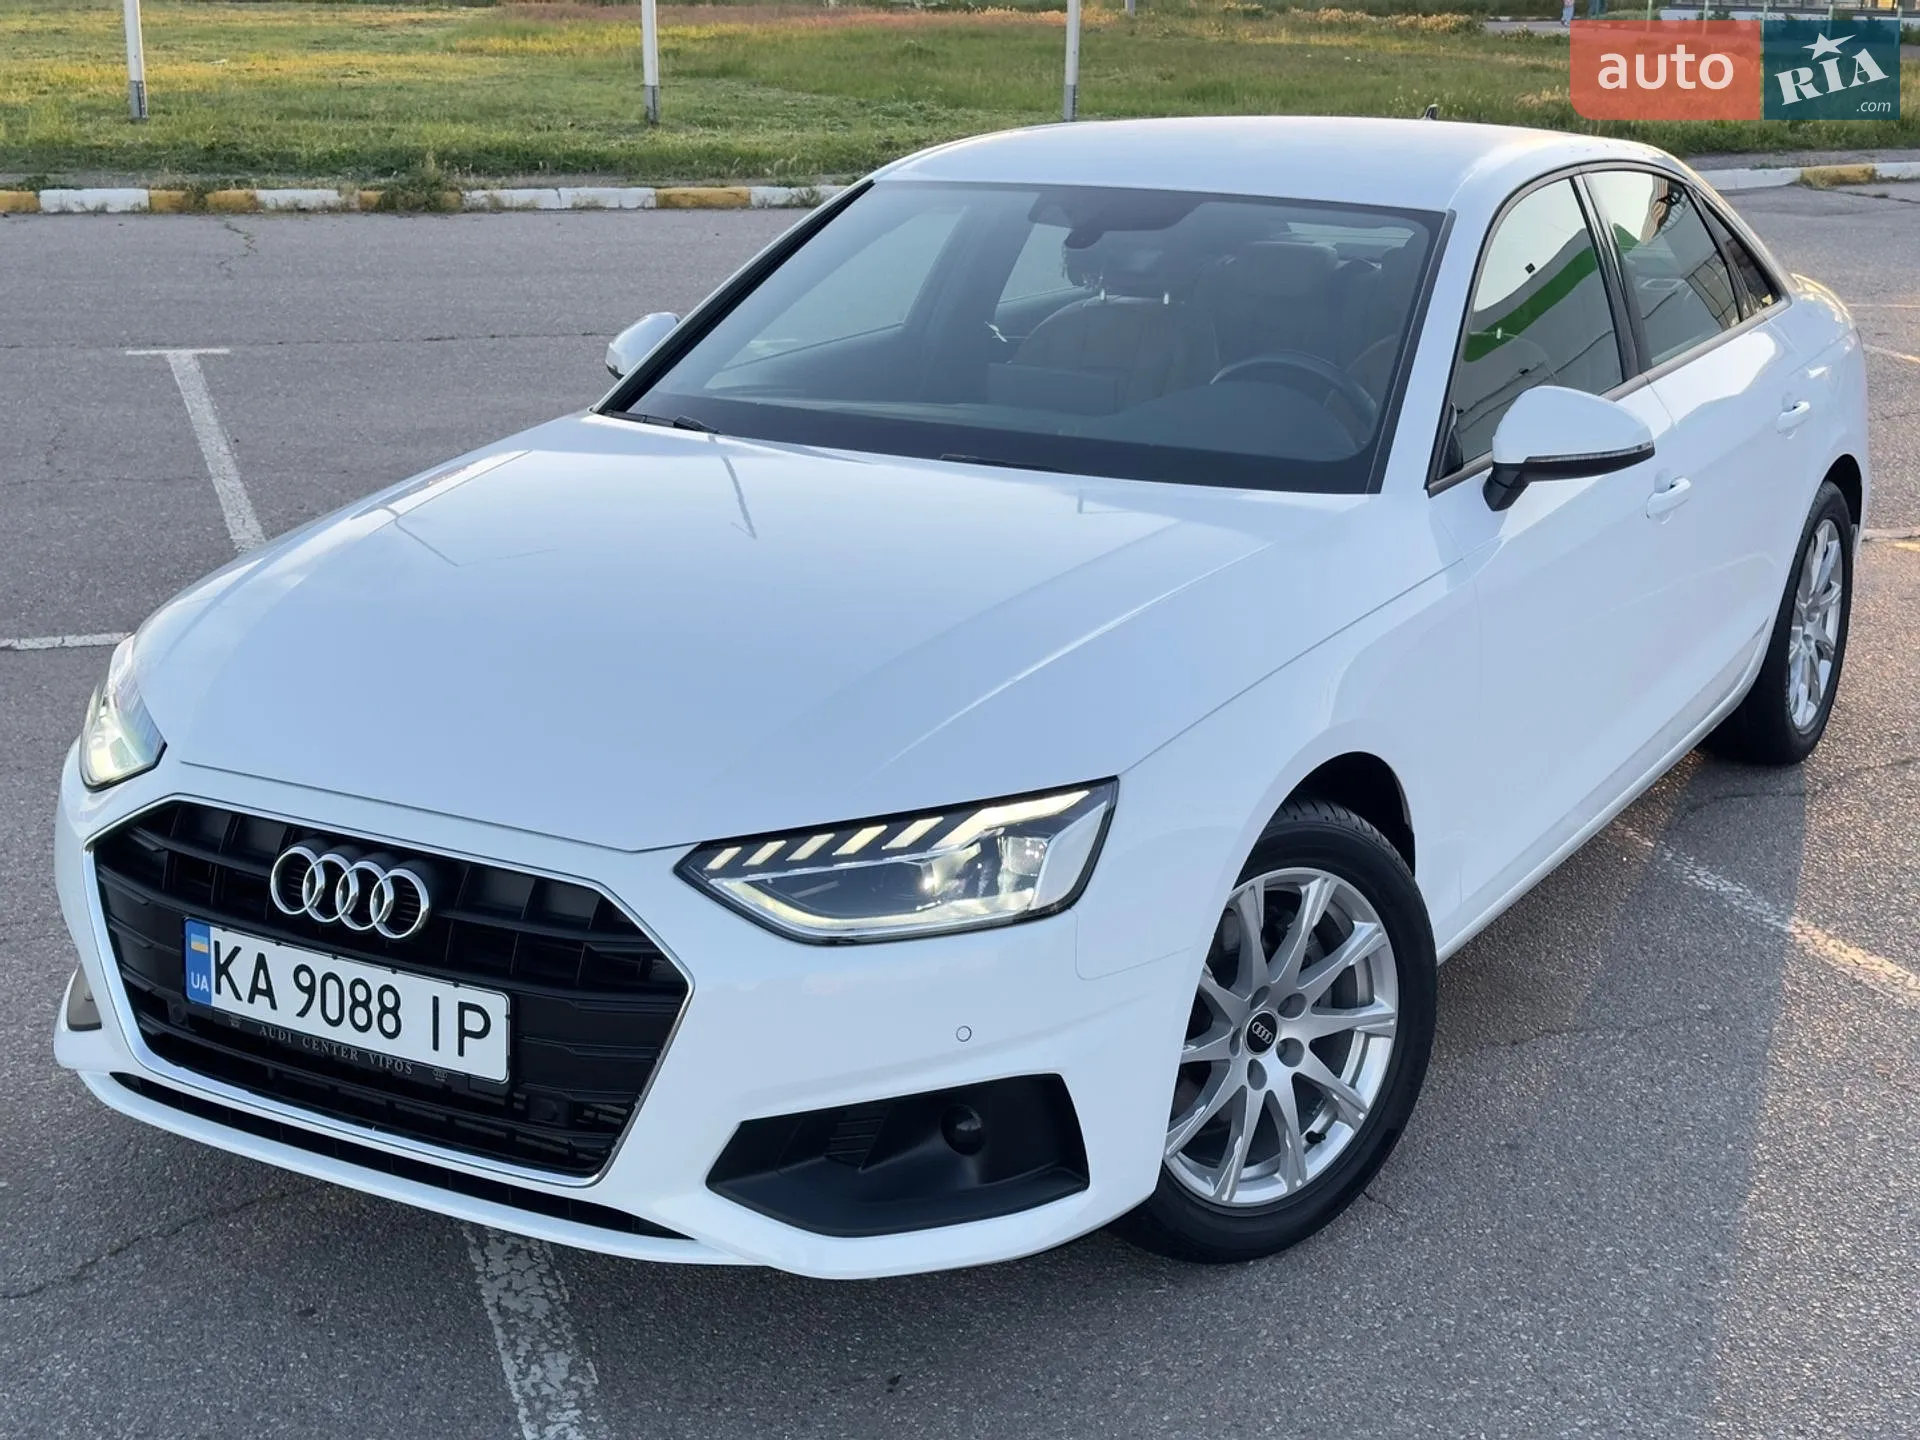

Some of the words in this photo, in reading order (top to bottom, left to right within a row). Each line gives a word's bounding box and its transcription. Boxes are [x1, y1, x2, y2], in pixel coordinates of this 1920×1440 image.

[191, 972, 209, 992] UA
[214, 940, 278, 1011] KA
[293, 963, 402, 1040] 9088
[432, 995, 492, 1057] IP
[259, 1026, 292, 1044] AUDI
[302, 1036, 359, 1062] CENTER
[367, 1053, 413, 1075] VIPOS
